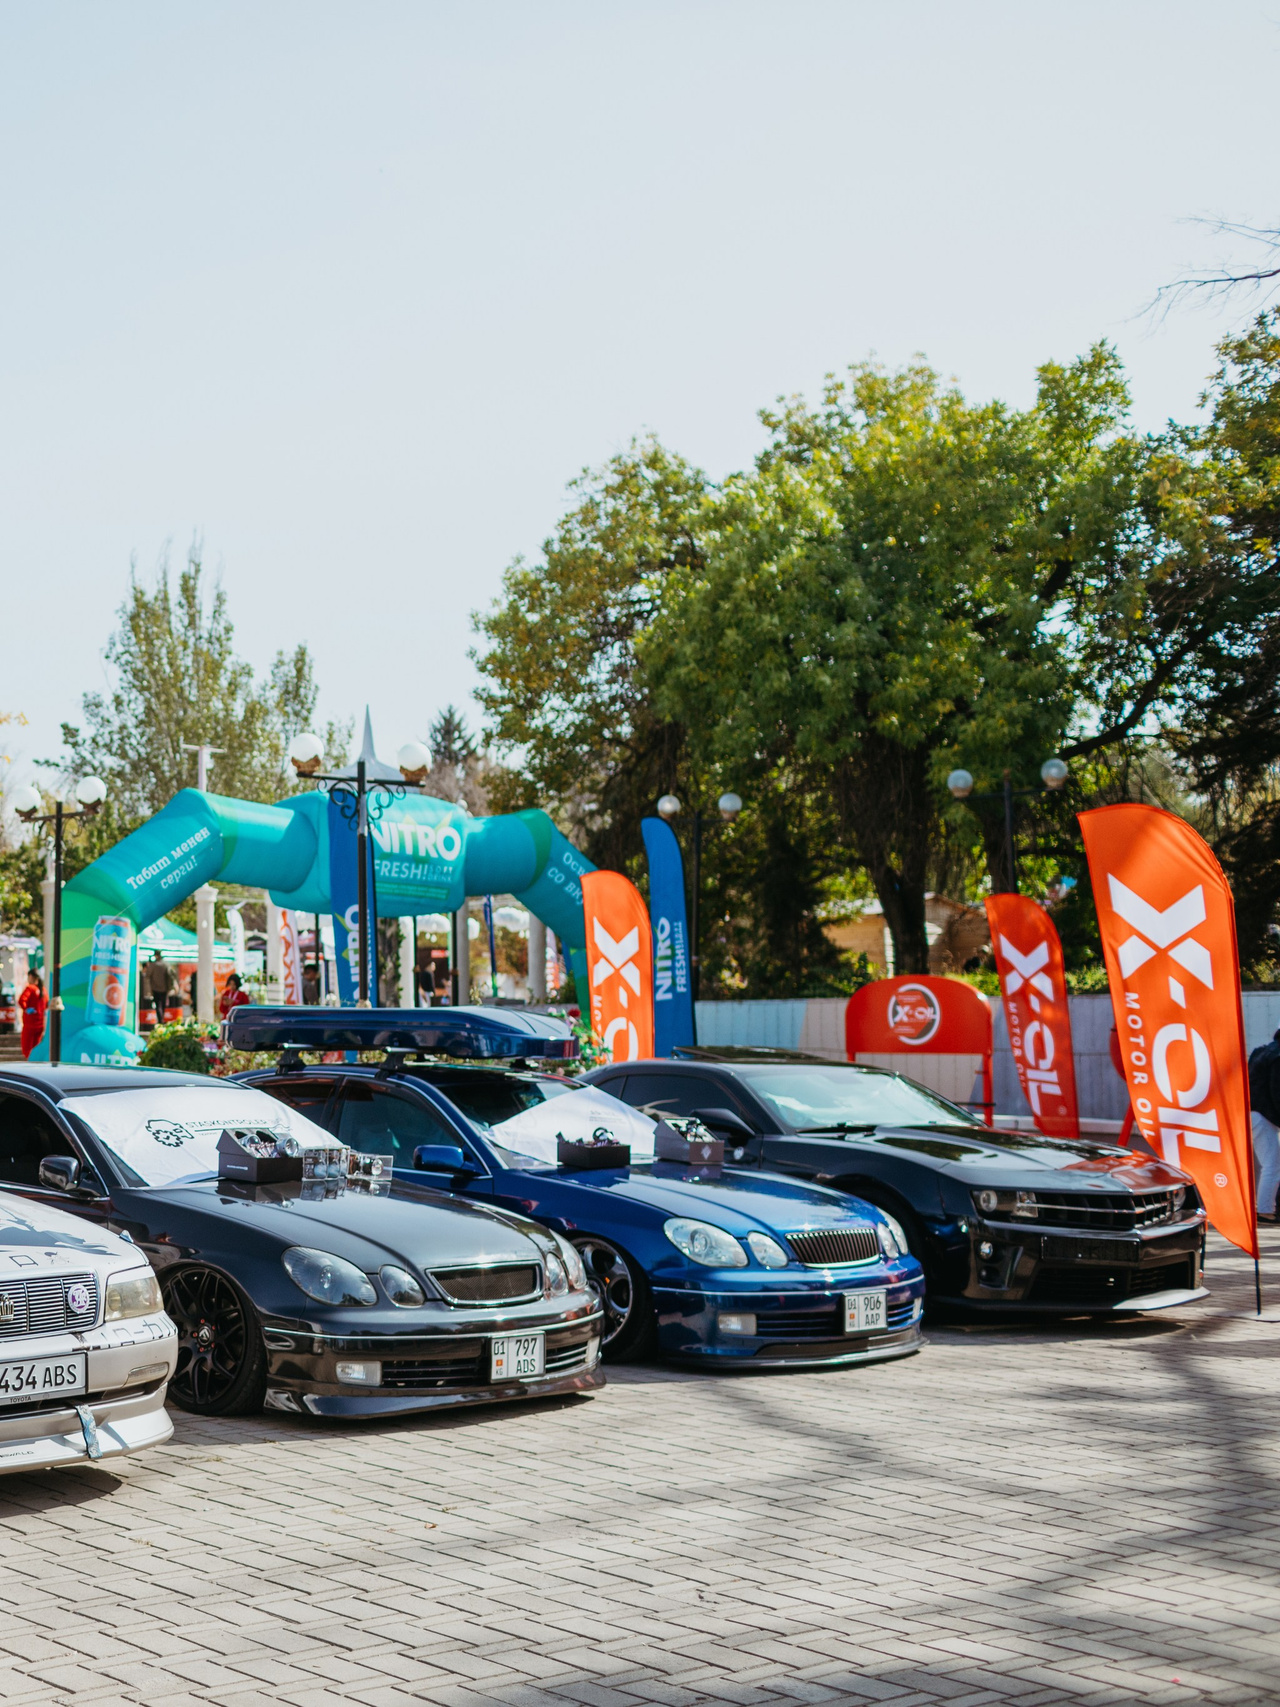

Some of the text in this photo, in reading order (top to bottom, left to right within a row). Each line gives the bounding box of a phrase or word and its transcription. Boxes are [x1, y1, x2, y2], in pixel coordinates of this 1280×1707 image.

[370, 821, 461, 861] NITRO
[126, 827, 211, 889] Табит менен
[655, 916, 673, 1001] NITRO
[998, 932, 1062, 1117] X-OIL
[1008, 1001, 1022, 1057] MOTOR
[1107, 872, 1221, 1169] X-OIL
[81, 1052, 141, 1066] NITR
[1125, 992, 1155, 1138] MOTOR OIL
[863, 1296, 881, 1311] 906
[865, 1313, 880, 1326] AAP
[493, 1341, 505, 1355] 01
[515, 1337, 537, 1356] 797
[42, 1363, 77, 1388] ABS
[516, 1358, 536, 1374] ADS
